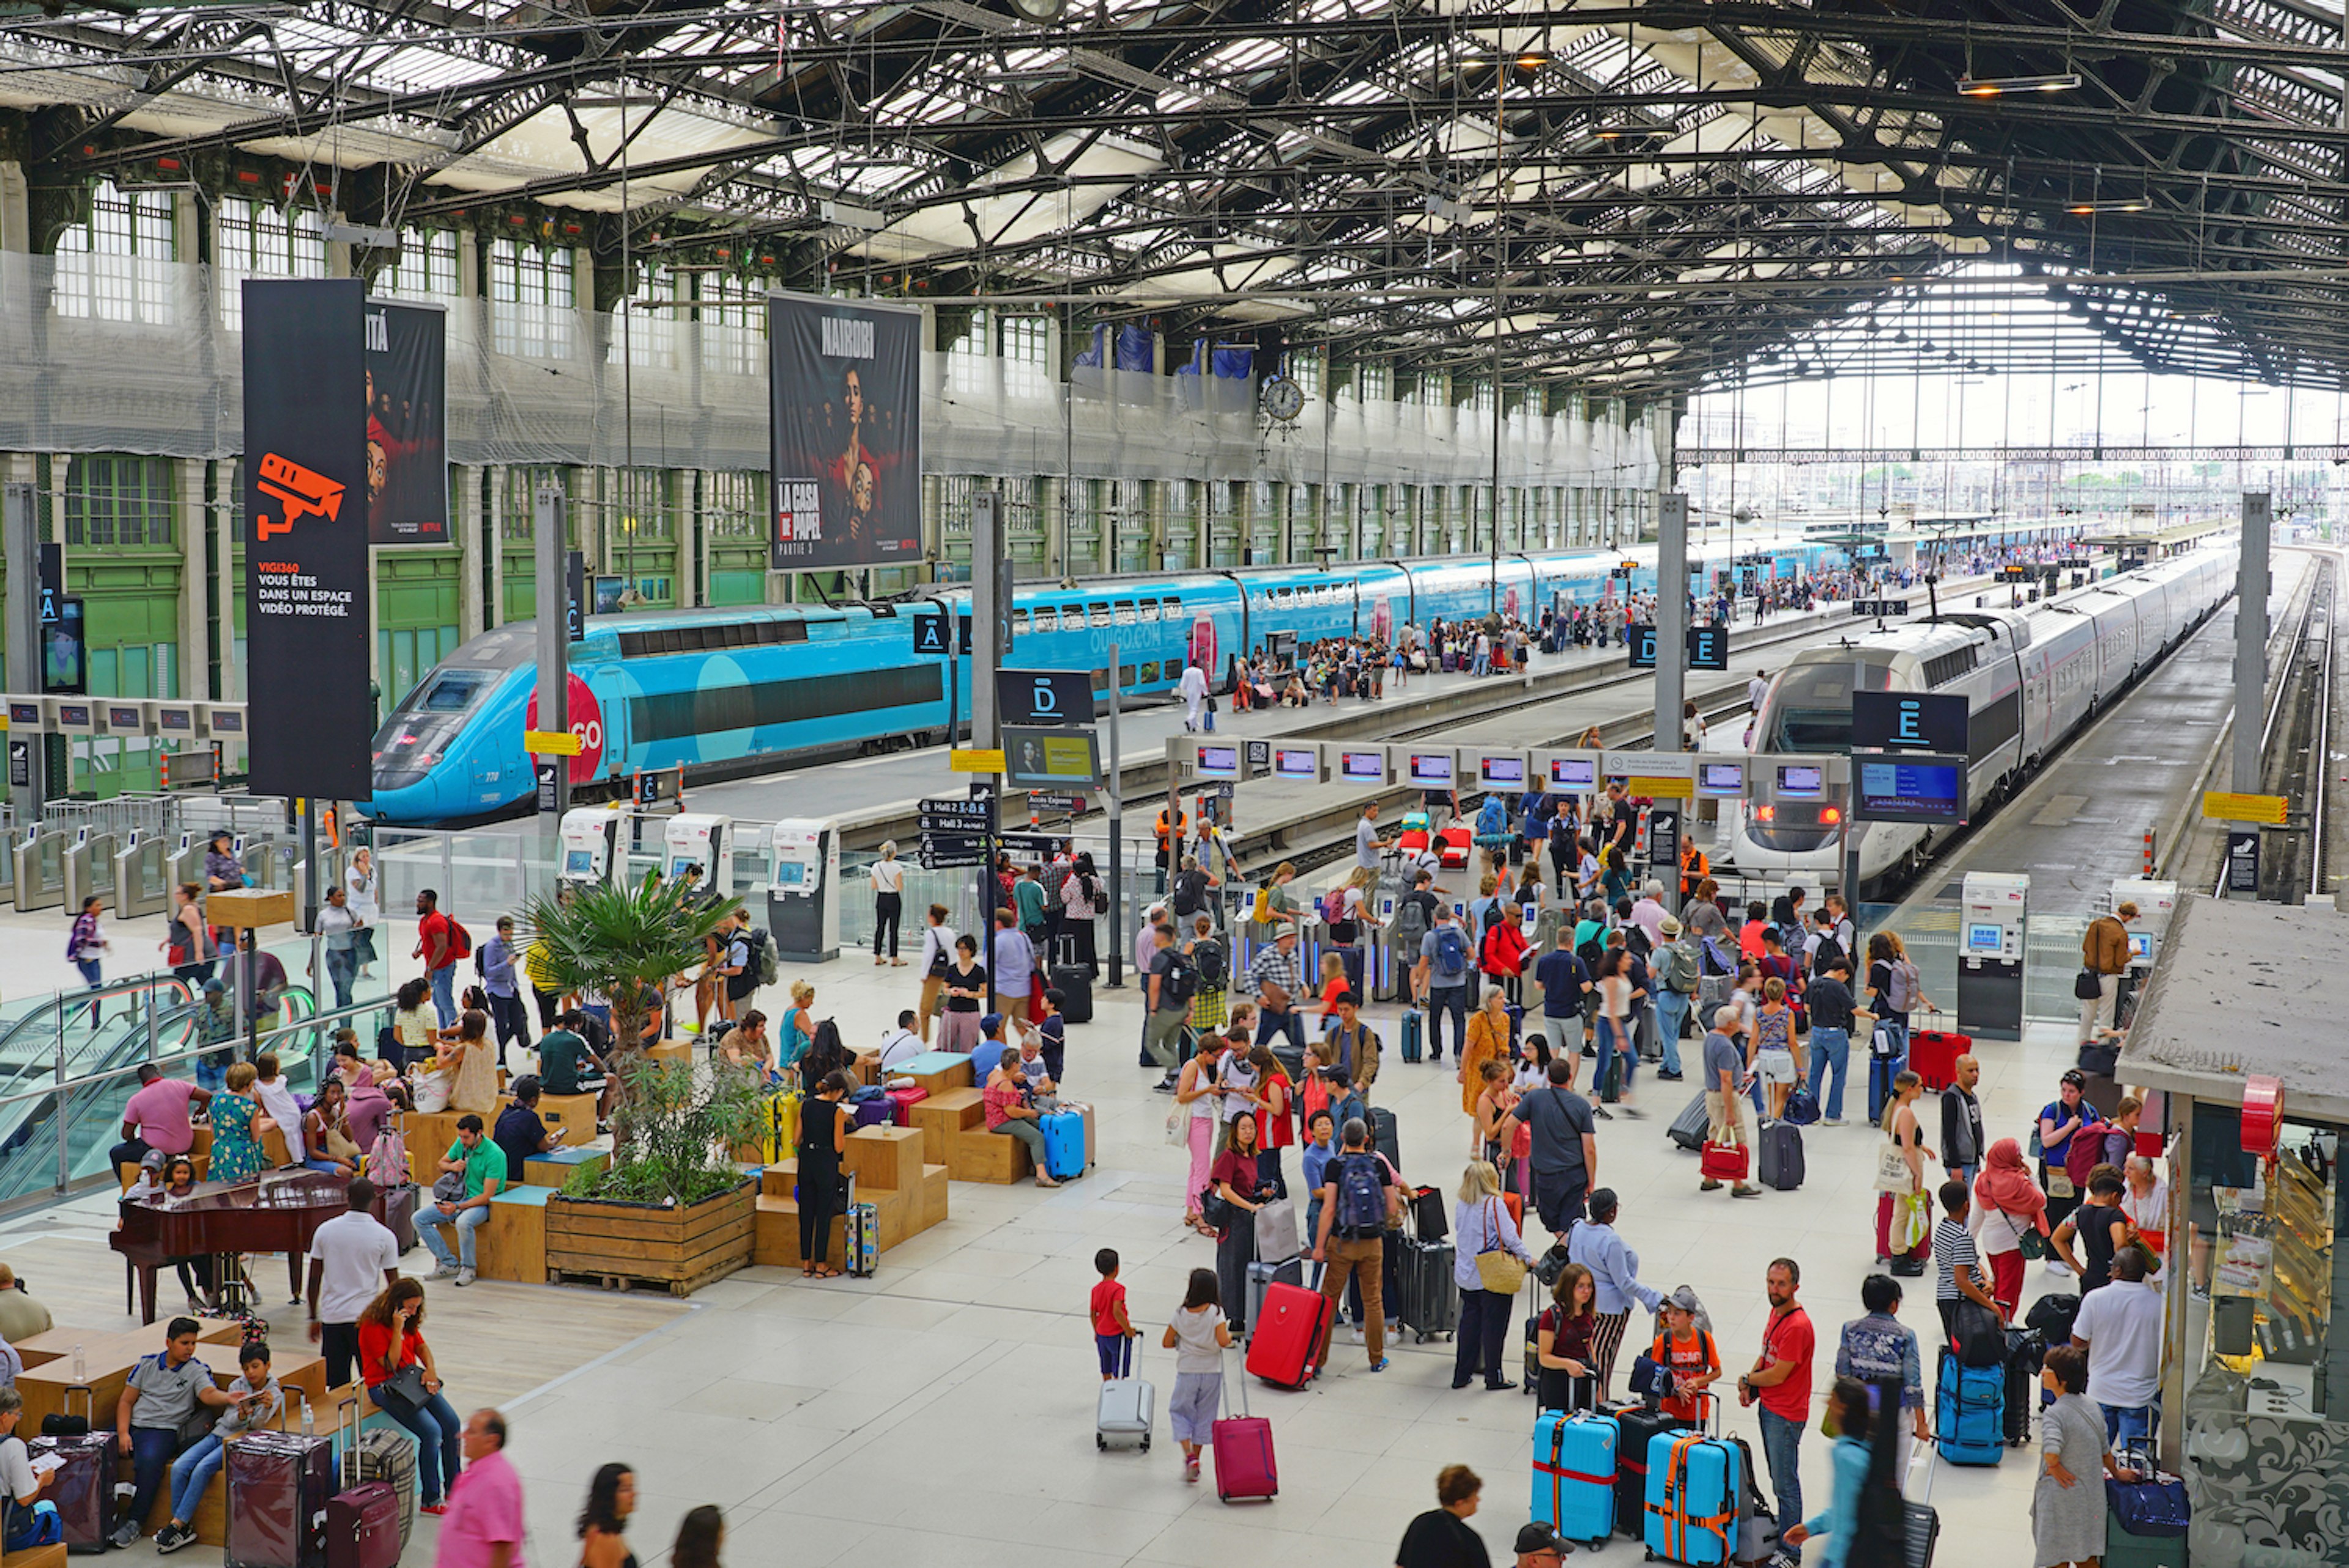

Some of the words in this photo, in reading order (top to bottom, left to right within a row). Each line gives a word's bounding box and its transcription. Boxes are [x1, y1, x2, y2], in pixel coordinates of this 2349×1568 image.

[822, 316, 875, 360] NAIROBI
[779, 483, 792, 512] LA
[792, 483, 819, 513] CASA
[782, 518, 791, 537] DE
[793, 512, 822, 540] PAPEL
[809, 542, 813, 554] 3
[258, 562, 299, 573] VIGI360
[258, 574, 289, 586] VOUS
[291, 573, 317, 587] ÊTES
[259, 589, 289, 600] DANS
[292, 589, 308, 601] UN
[311, 590, 352, 603] ESPACE
[42, 596, 55, 617] A
[259, 601, 294, 615] VIDÉO
[295, 603, 349, 617] PROTÉGÉ.
[1865, 603, 1874, 614] R
[1887, 603, 1896, 614] R
[568, 609, 577, 631] C
[924, 626, 939, 645] A
[1090, 623, 1161, 654] OUIGO.COM
[1699, 641, 1713, 660] E
[1033, 686, 1056, 712] D
[1900, 711, 1920, 737] E
[934, 801, 951, 812] Hall
[951, 803, 958, 812] 2
[939, 819, 956, 828] Hall
[956, 819, 962, 829] 3
